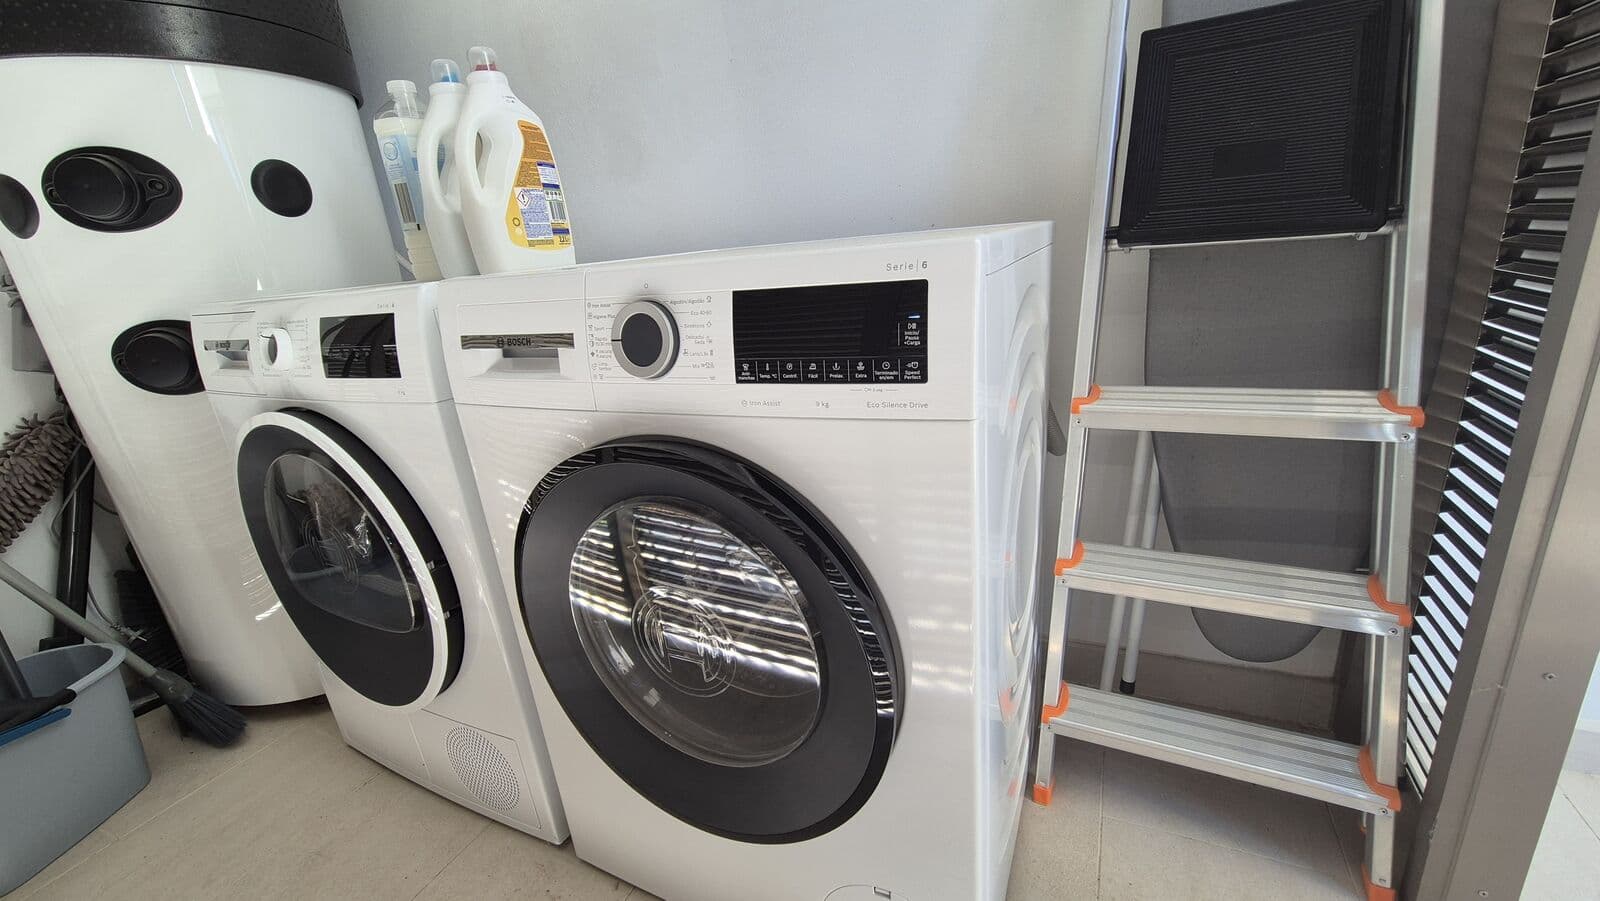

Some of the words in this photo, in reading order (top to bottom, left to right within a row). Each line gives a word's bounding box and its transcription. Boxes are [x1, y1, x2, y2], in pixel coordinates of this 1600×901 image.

[886, 262, 914, 272] Serie
[921, 260, 928, 269] 6
[507, 337, 532, 347] BOSCH
[821, 400, 830, 408] kg
[866, 401, 880, 409] Eco
[881, 400, 908, 409] Silence
[909, 401, 929, 409] Drive
